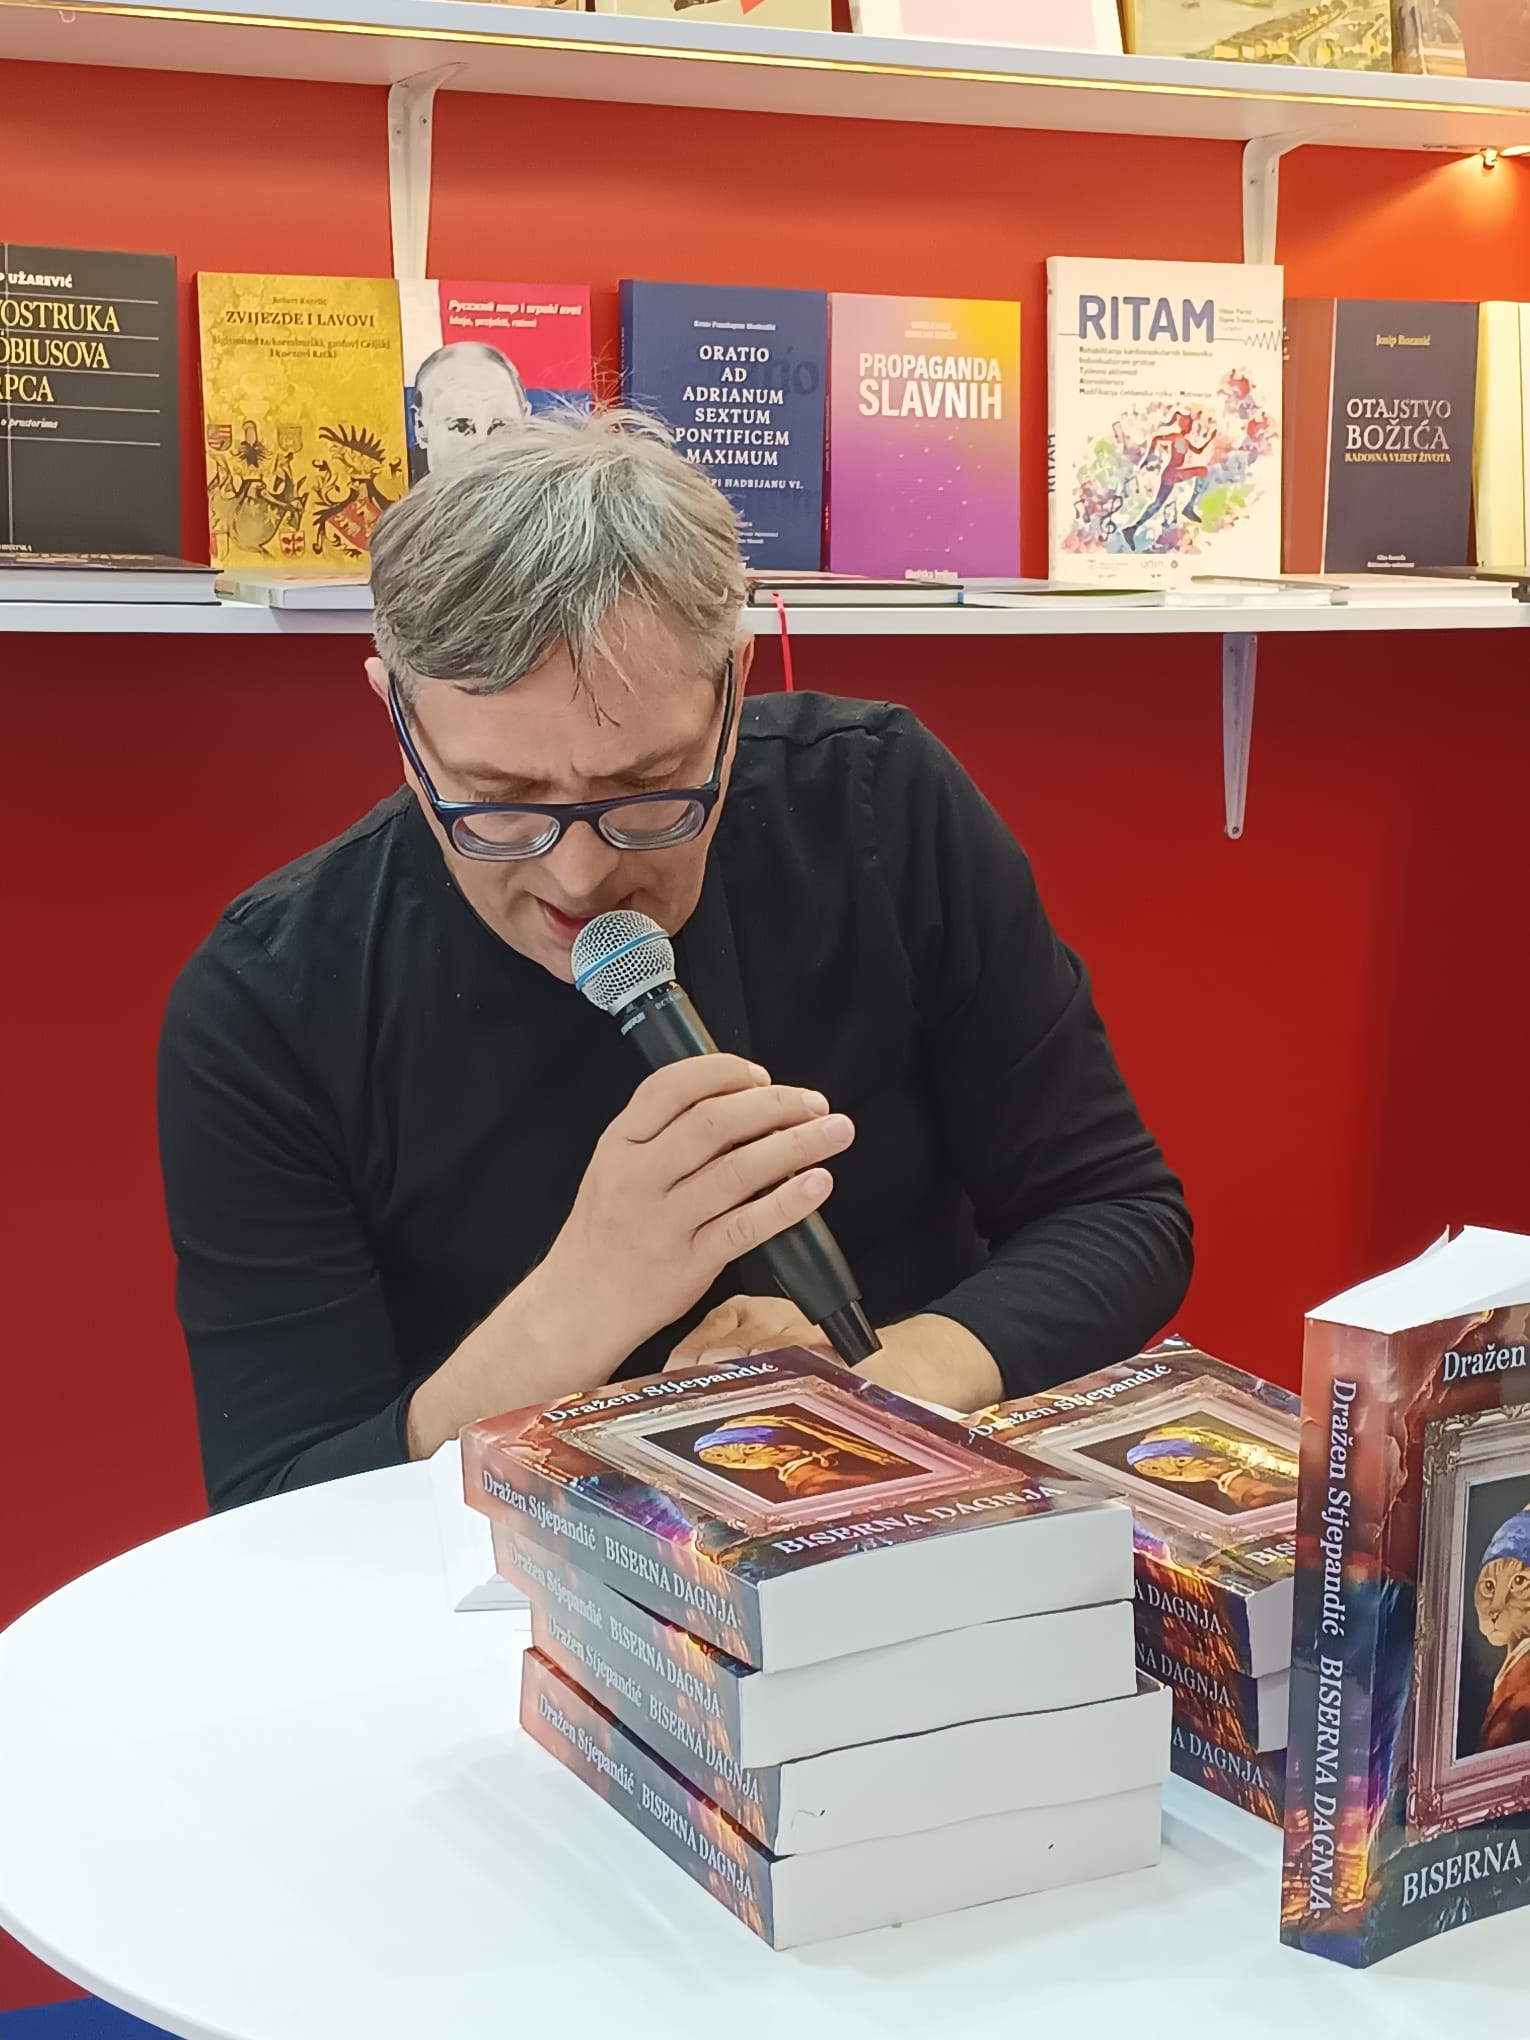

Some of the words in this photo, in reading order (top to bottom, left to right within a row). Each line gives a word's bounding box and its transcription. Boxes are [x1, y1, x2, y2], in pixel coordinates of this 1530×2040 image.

[8, 270, 73, 288] UŽAREVIĆ
[0, 299, 120, 332] OSTRUKA
[226, 311, 304, 326] ZVIJEZDE
[308, 313, 313, 326] I
[317, 313, 375, 328] LAVOVI
[1079, 295, 1214, 343] RITAM
[700, 345, 770, 362] ORATIO
[721, 367, 747, 382] AD
[859, 352, 1001, 382] PROPAGANDA
[0, 373, 54, 402] PCA
[683, 386, 784, 405] ADRIANUM
[858, 378, 1002, 420] SLAVNIH
[1346, 398, 1451, 418] OTAJSTVO
[675, 428, 790, 446] PONTIFICEM
[695, 408, 770, 425] SEXTUM
[1345, 418, 1450, 450] BOŽIĆA
[686, 448, 778, 466] MAXIMUM
[1345, 453, 1387, 462] RADOSNA
[1418, 451, 1451, 462] ŽIVOTA
[1442, 1343, 1527, 1382] Dražen
[544, 1389, 641, 1422] Dražen
[643, 1363, 779, 1398] Stjepandić
[1054, 1364, 1172, 1410] Stjepandić
[1328, 1378, 1357, 1481] Dražen
[772, 1512, 932, 1554] BISERNA
[928, 1485, 1067, 1520] DAGNJA
[483, 1470, 527, 1514] Dražen
[527, 1494, 597, 1551] Stjepandić
[605, 1536, 671, 1593] BISERNA
[673, 1573, 738, 1629] DAGNJA
[1321, 1486, 1351, 1637] Stjepandić
[1148, 1583, 1222, 1634] DAGNJA
[546, 1569, 602, 1630] Stjepandić
[610, 1616, 665, 1677] BISERNA
[667, 1659, 721, 1717] DAGNJA
[1161, 1653, 1234, 1708] DAGNJA
[586, 1643, 642, 1708] Stjepandić
[650, 1695, 704, 1758] BISERNA
[706, 1741, 759, 1804] DAGNJA
[1315, 1655, 1344, 1786] BISERNA
[1173, 1727, 1185, 1750] A
[1189, 1733, 1265, 1788] DAGNJA
[539, 1694, 576, 1742] Dražen
[578, 1728, 634, 1795] Stjepandić
[642, 1783, 698, 1851] BISERNA
[699, 1833, 754, 1901] DAGNJA
[1309, 1791, 1337, 1912] DAGNJA
[1402, 1839, 1522, 1908] BISERNA
